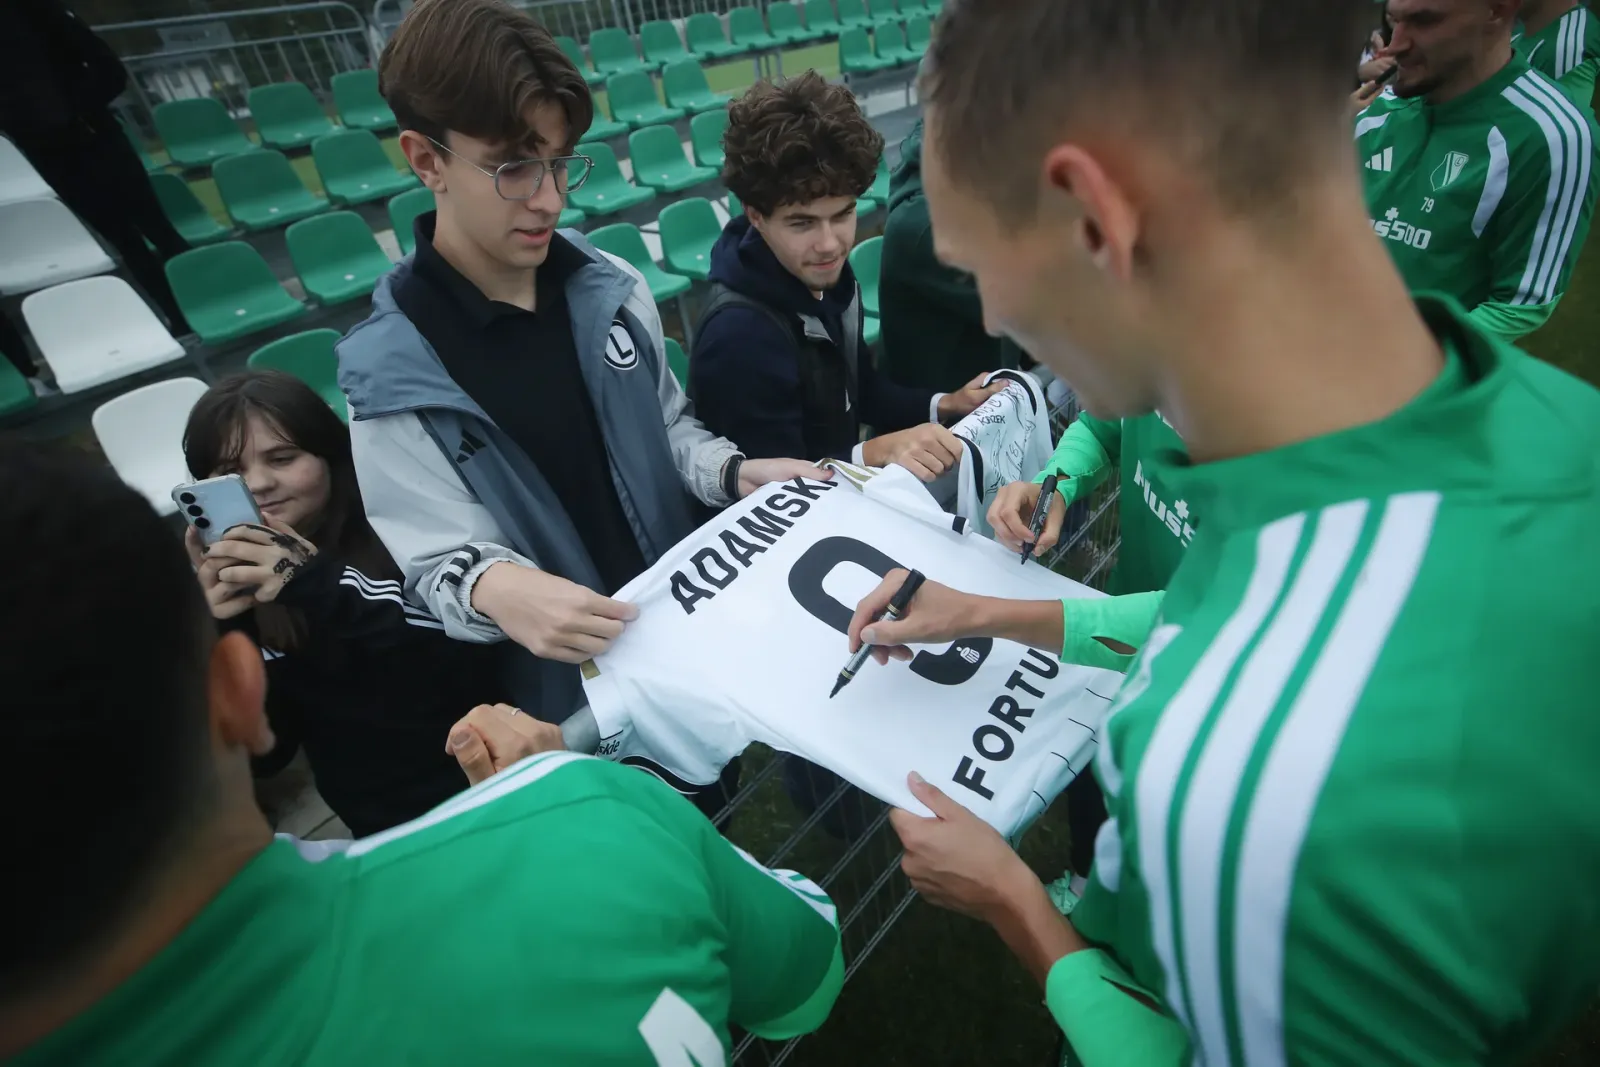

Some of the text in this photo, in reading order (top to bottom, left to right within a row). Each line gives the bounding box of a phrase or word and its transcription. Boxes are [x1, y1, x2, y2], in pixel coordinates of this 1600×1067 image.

[1420, 196, 1435, 213] 79
[1369, 218, 1432, 250] s500
[608, 332, 633, 360] L
[788, 536, 993, 686] 9
